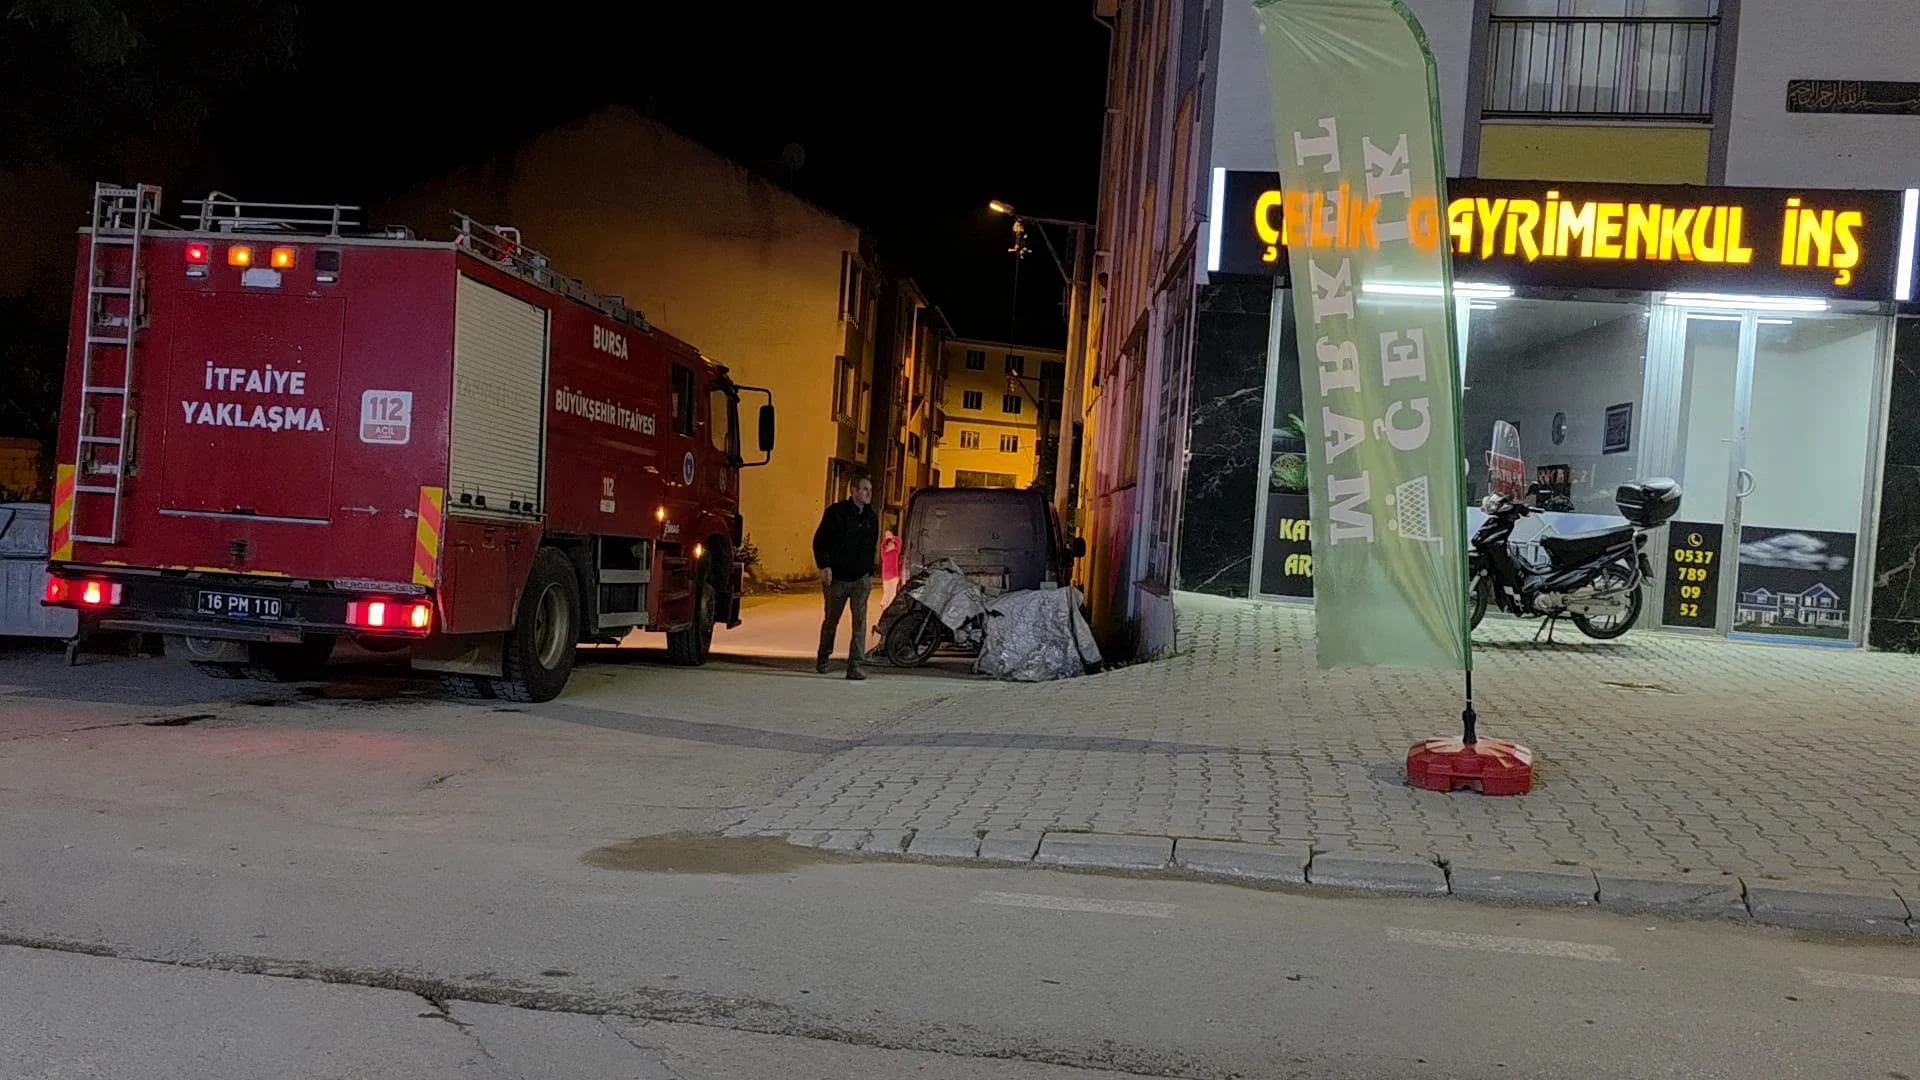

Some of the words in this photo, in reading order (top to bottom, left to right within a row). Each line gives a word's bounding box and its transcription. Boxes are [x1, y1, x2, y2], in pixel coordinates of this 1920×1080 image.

[1254, 183, 1379, 262] ÇELİK
[1406, 190, 1754, 263] GAYRİMENKUL
[1779, 197, 1863, 286] İNŞ
[593, 324, 628, 360] BURSA
[205, 361, 306, 395] İTFAİYE
[181, 400, 324, 432] YAKLAŞMA
[369, 396, 404, 422] 112
[555, 385, 616, 426] BÜYÜKŞEHİR
[617, 402, 656, 436] İTFAİYESİ
[602, 477, 615, 497] 112
[1674, 549, 1714, 565] 0537
[1678, 567, 1707, 582] 789
[1680, 585, 1701, 599] 09
[207, 594, 223, 609] 16
[228, 596, 249, 613] PM
[255, 599, 279, 615] 110
[1679, 602, 1698, 617] 52
